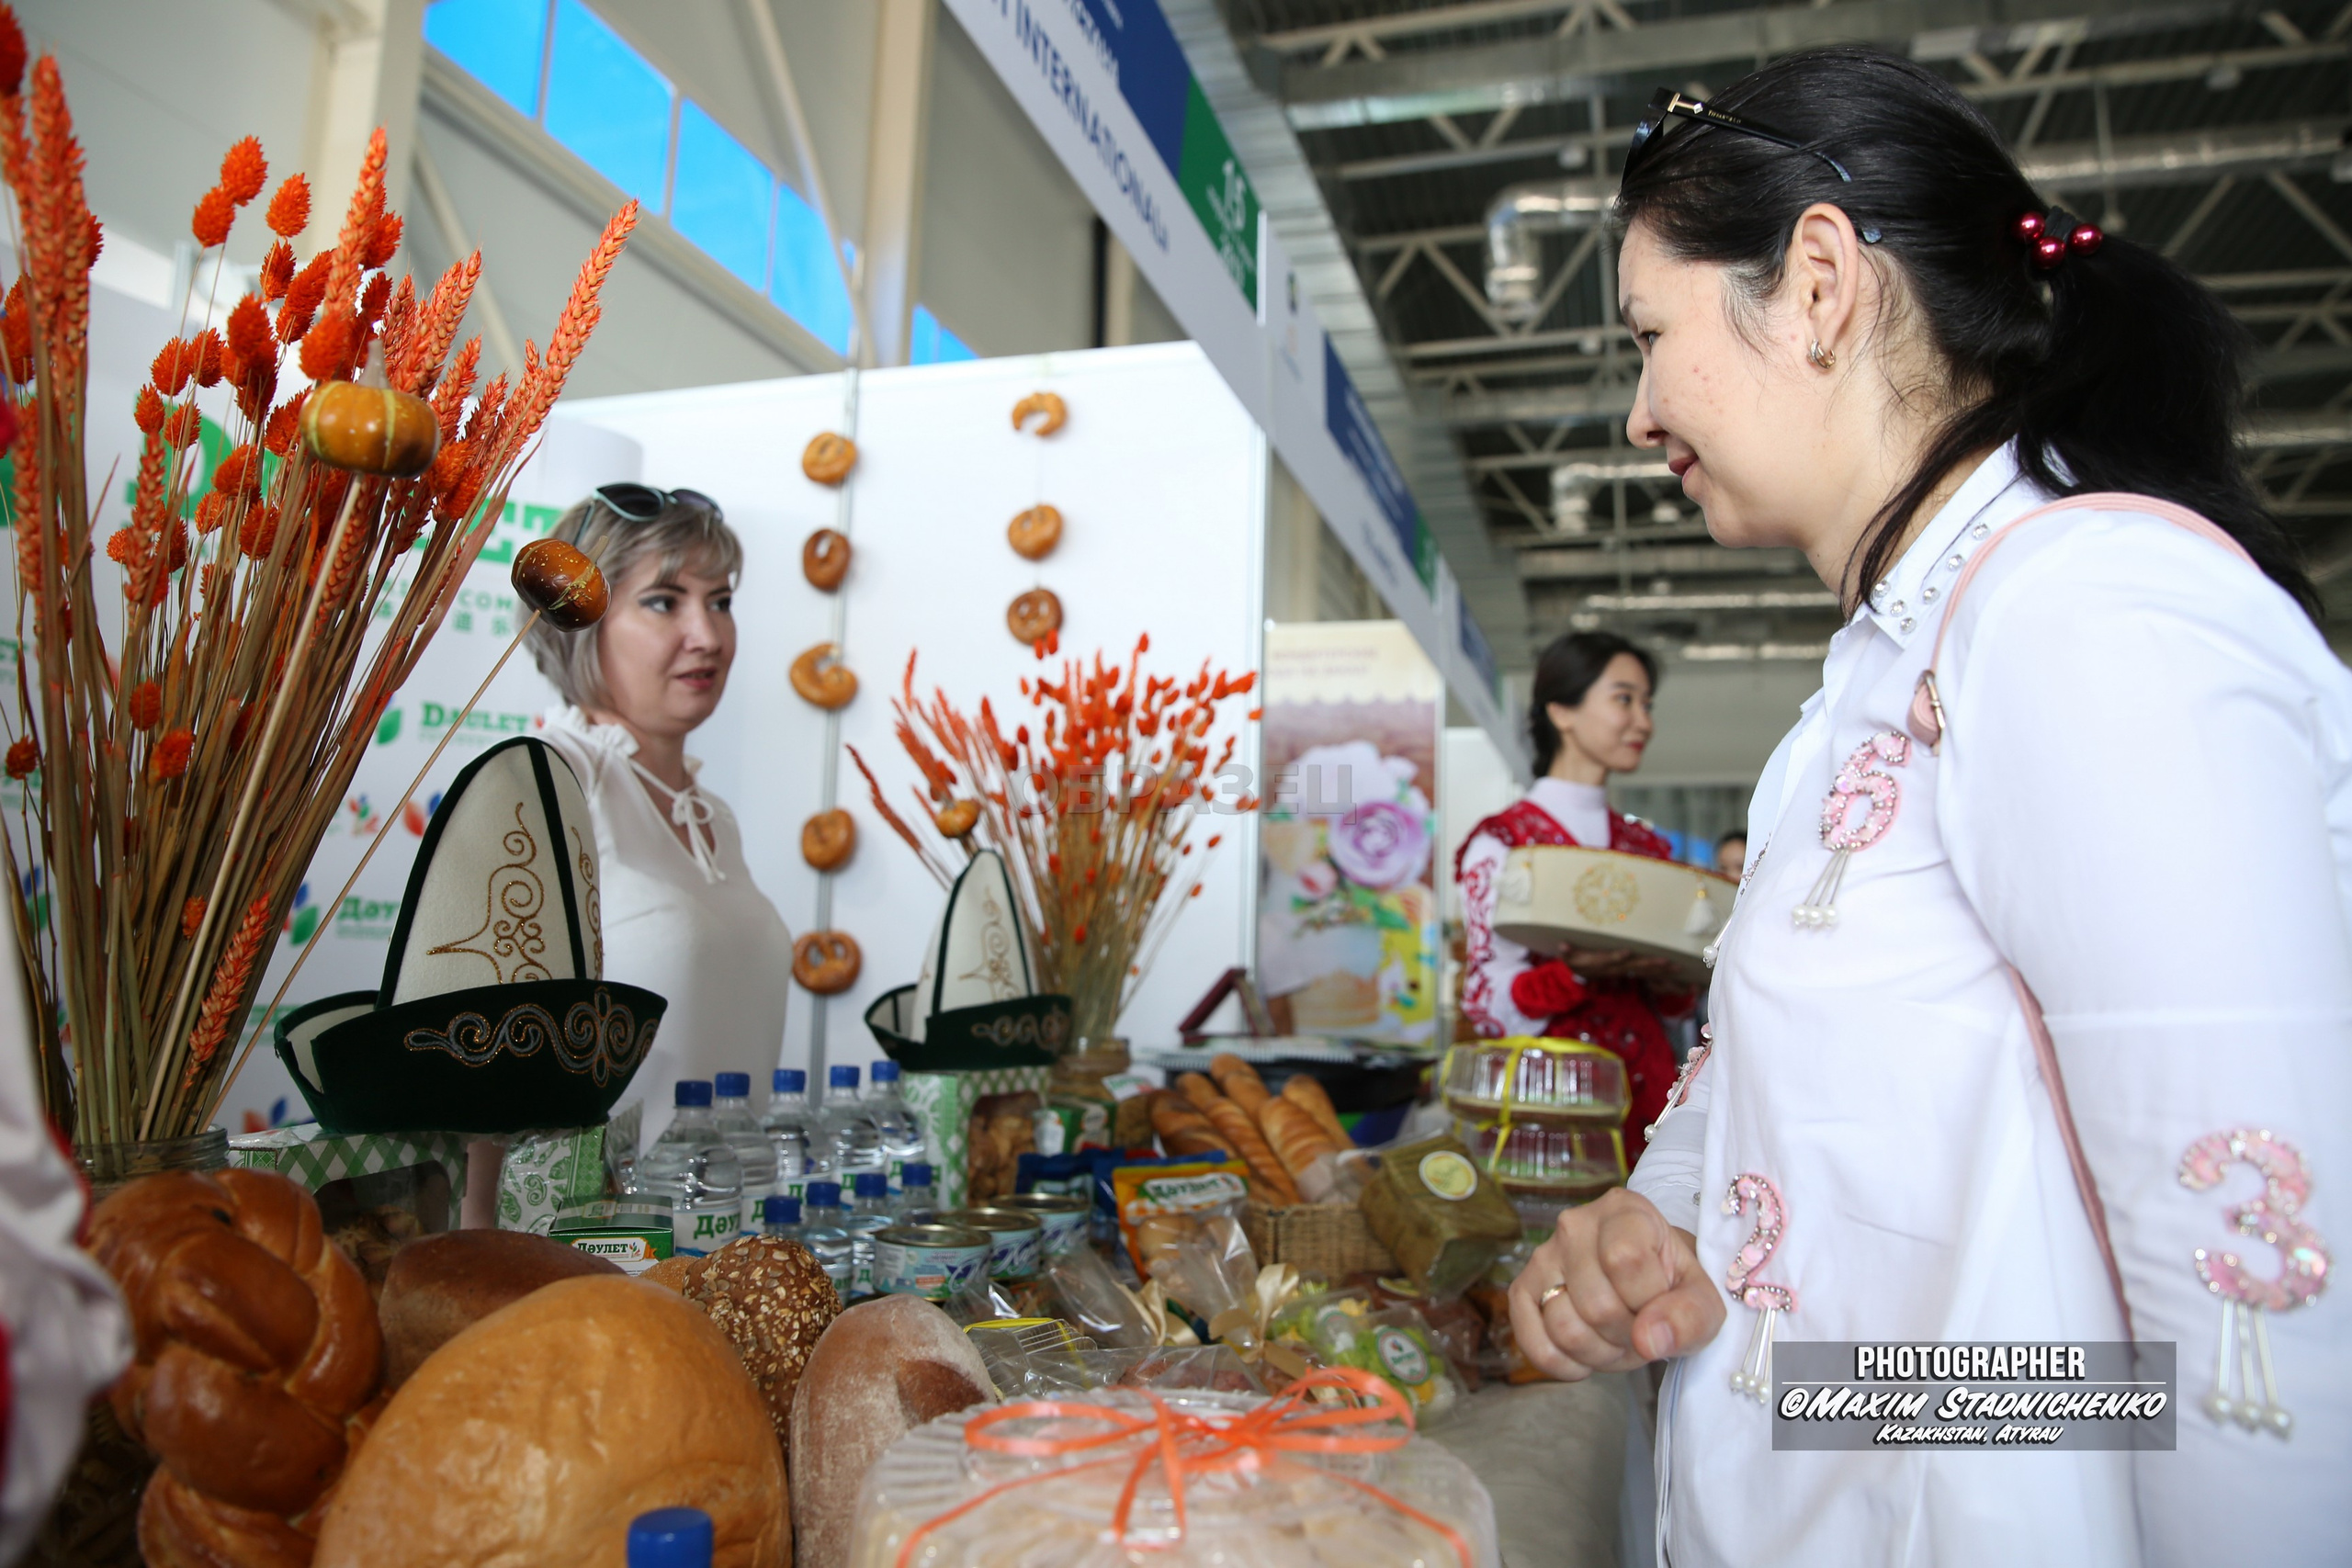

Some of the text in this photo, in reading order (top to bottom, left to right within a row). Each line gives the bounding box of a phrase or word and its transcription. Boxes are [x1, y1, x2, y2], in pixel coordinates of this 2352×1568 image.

[1816, 731, 1912, 852] 6
[1721, 1172, 1798, 1313] 2
[2177, 1127, 2335, 1313] 3
